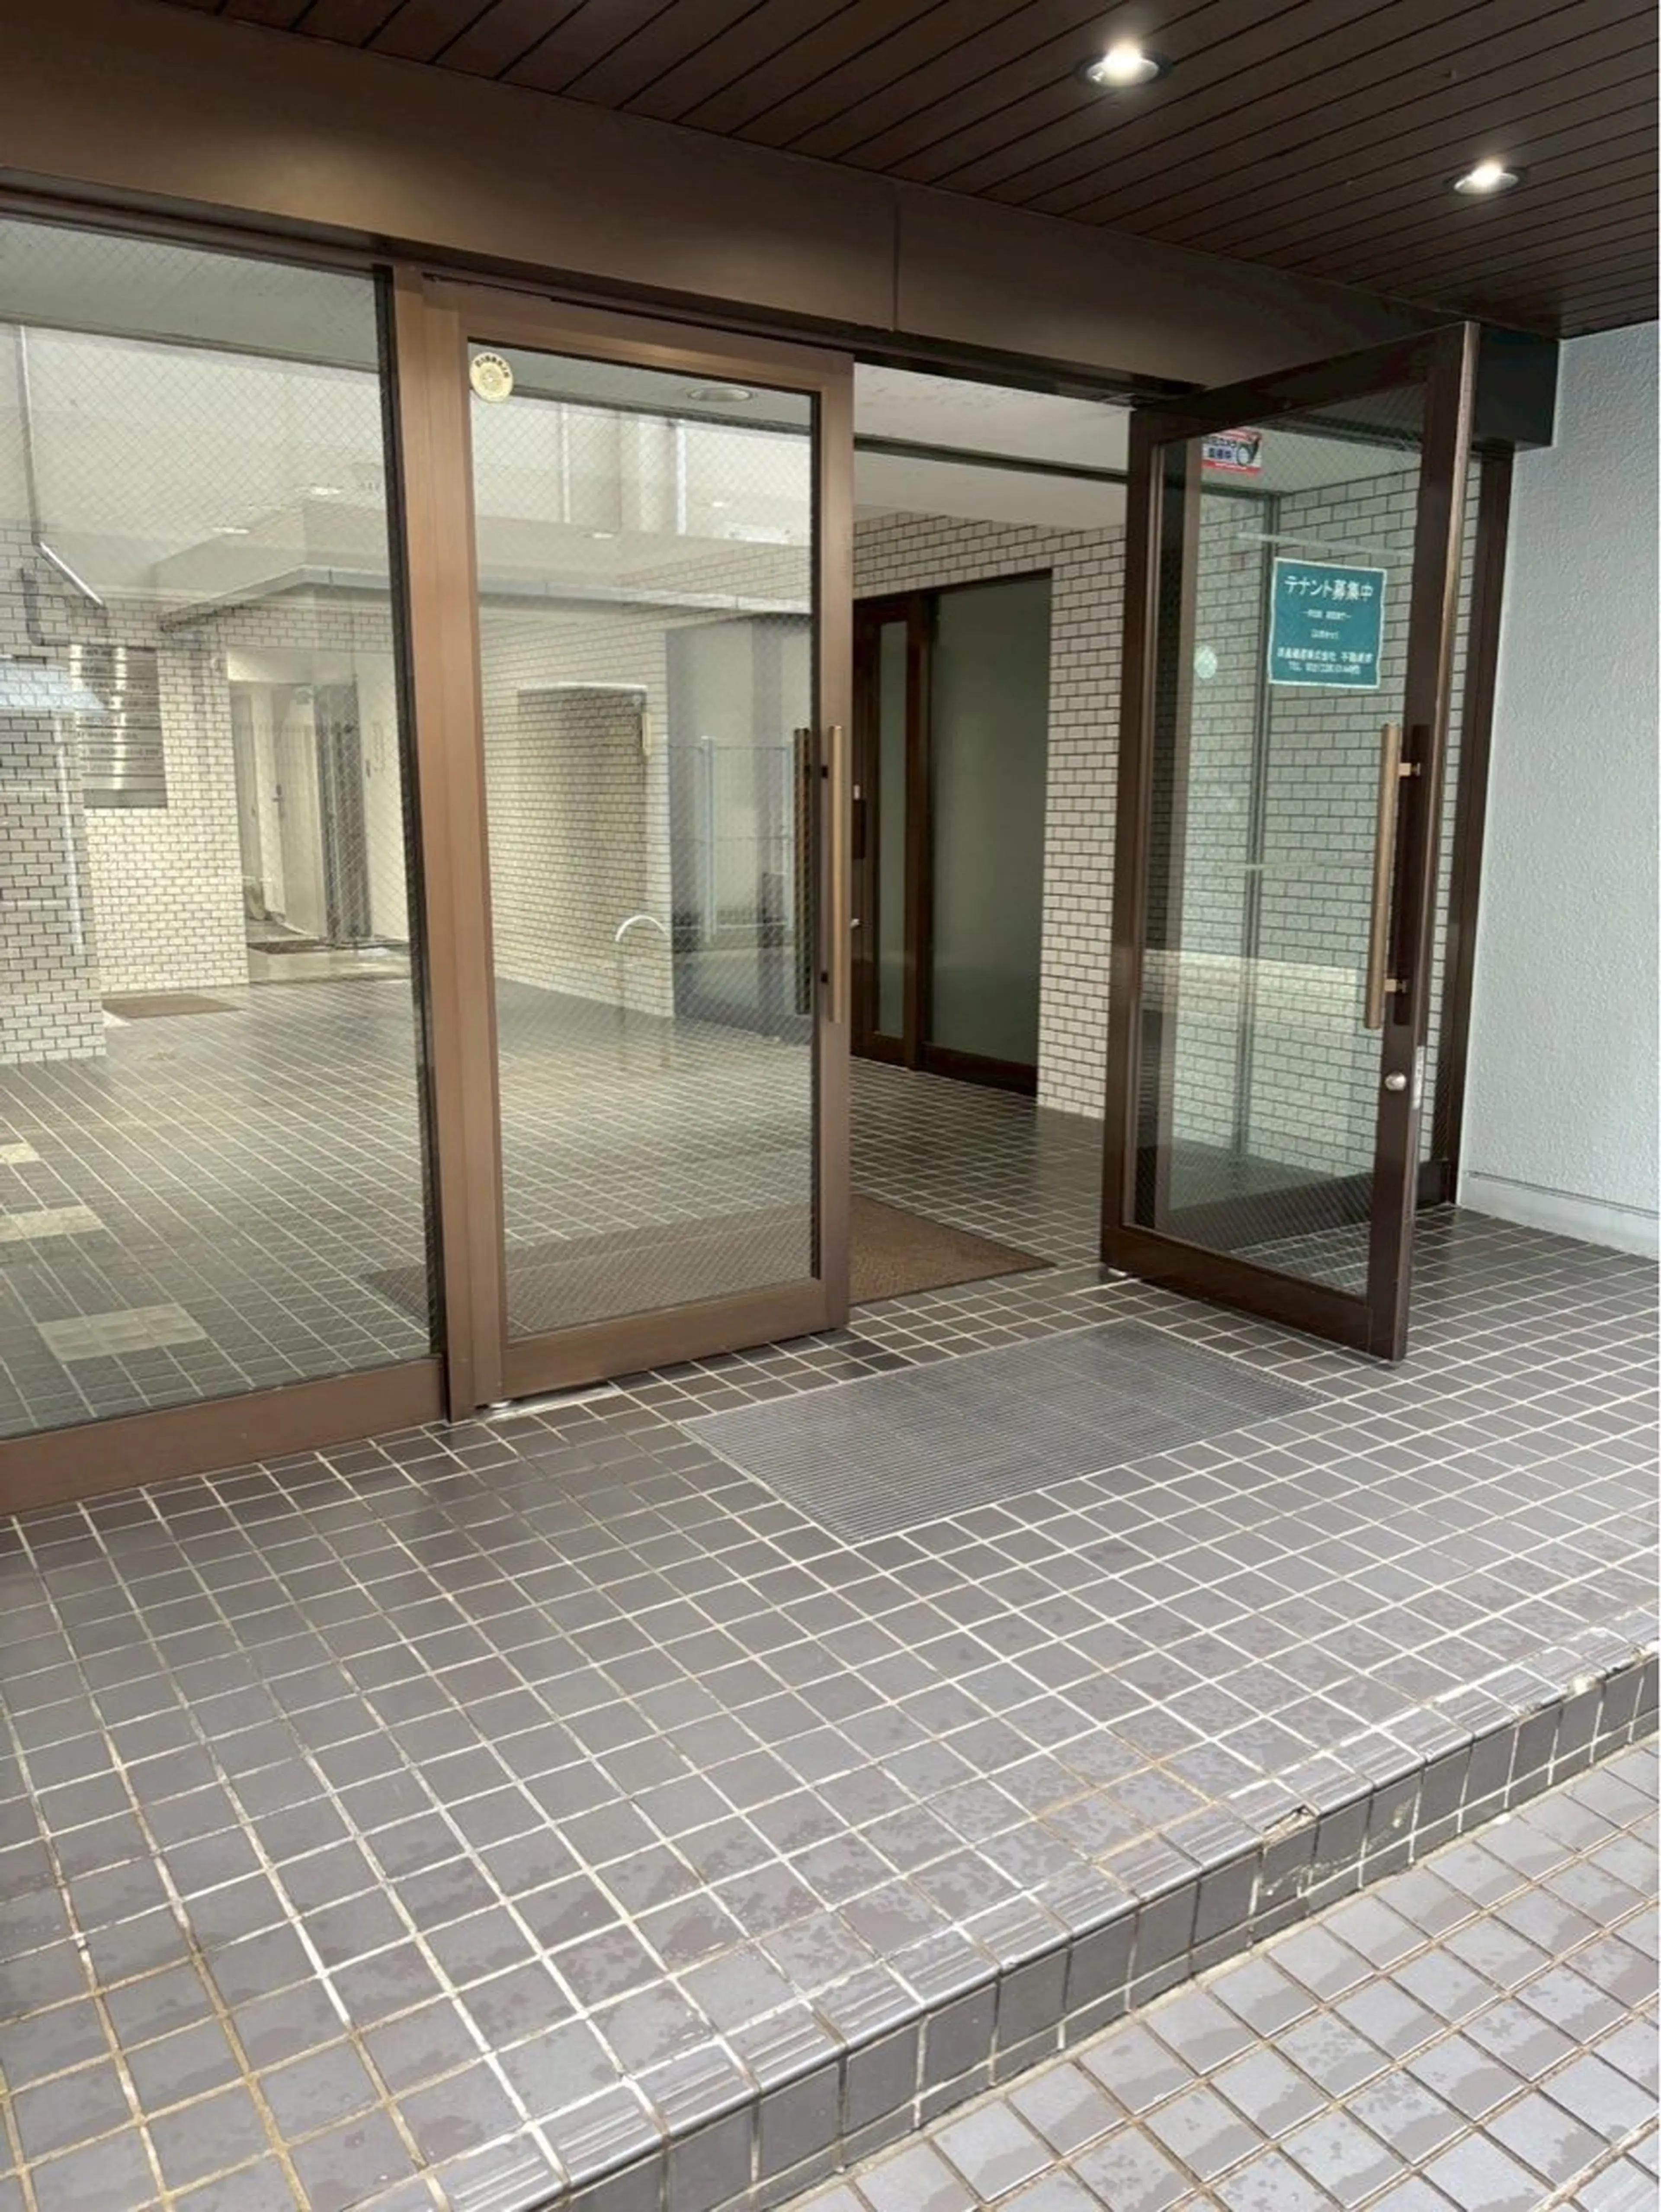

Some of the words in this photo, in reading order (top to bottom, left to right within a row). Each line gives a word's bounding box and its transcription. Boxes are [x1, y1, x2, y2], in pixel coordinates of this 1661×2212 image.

[1284, 575, 1373, 602] テナント募集中
